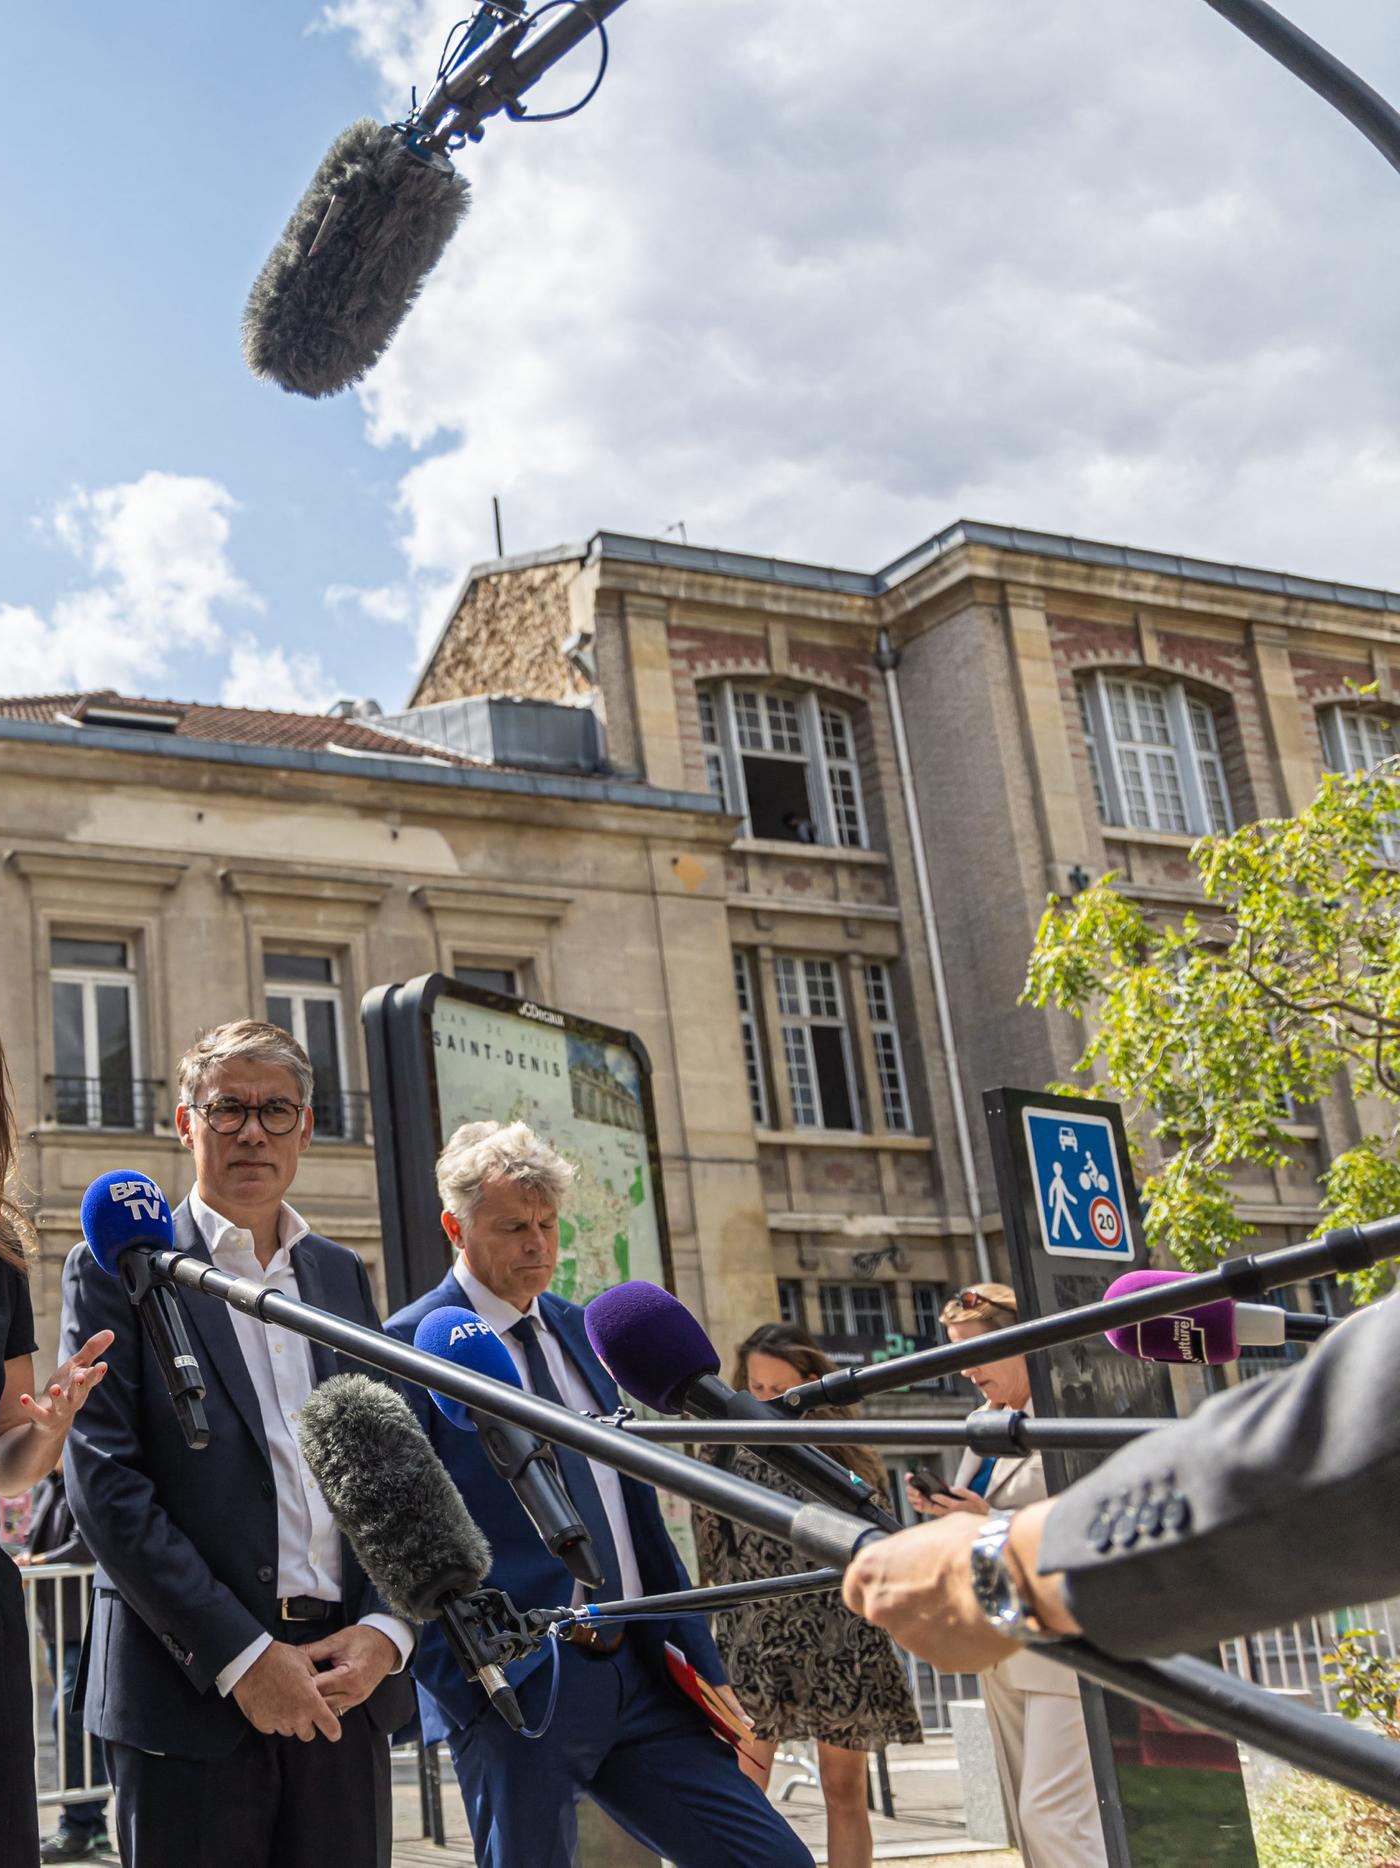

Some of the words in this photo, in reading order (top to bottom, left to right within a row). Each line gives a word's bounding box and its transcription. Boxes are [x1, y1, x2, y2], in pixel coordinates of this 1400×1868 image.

[440, 1011, 467, 1026] LAN
[518, 1002, 565, 1027] JCDecaux
[432, 1030, 560, 1077] SAINT-DENIS
[109, 1181, 165, 1203] BFM
[1098, 1213, 1114, 1230] 20
[449, 1322, 490, 1346] AFP
[1178, 1321, 1193, 1360] culture
